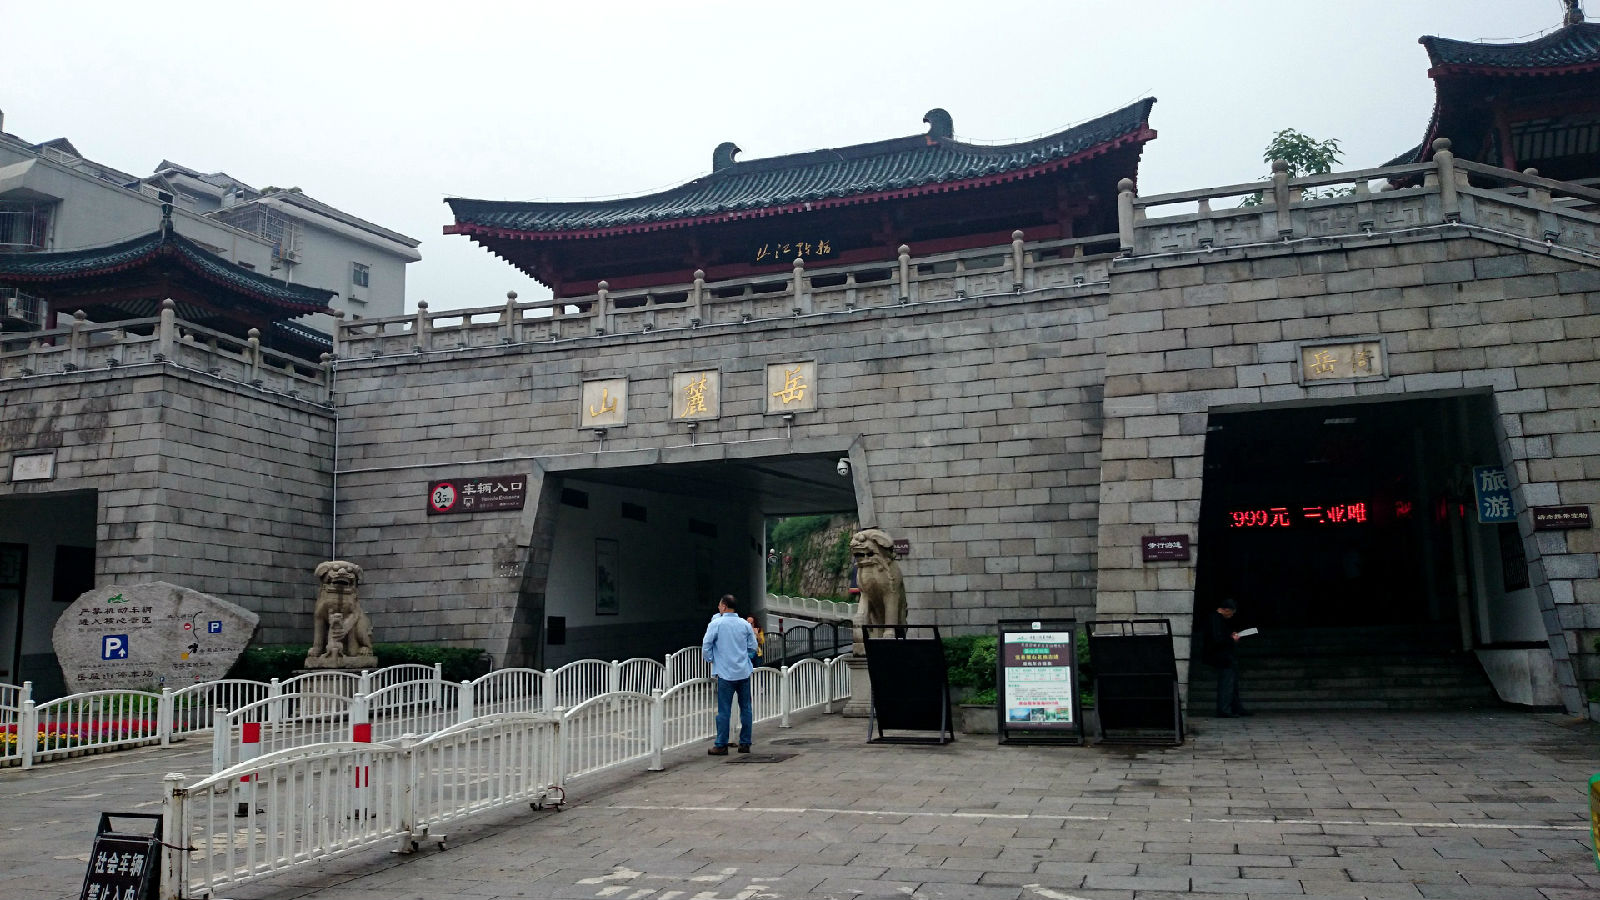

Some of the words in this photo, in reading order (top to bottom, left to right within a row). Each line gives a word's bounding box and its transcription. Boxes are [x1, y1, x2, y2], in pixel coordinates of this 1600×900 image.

[462, 482, 522, 495] 车辆入口
[94, 851, 145, 877] 社会车辆
